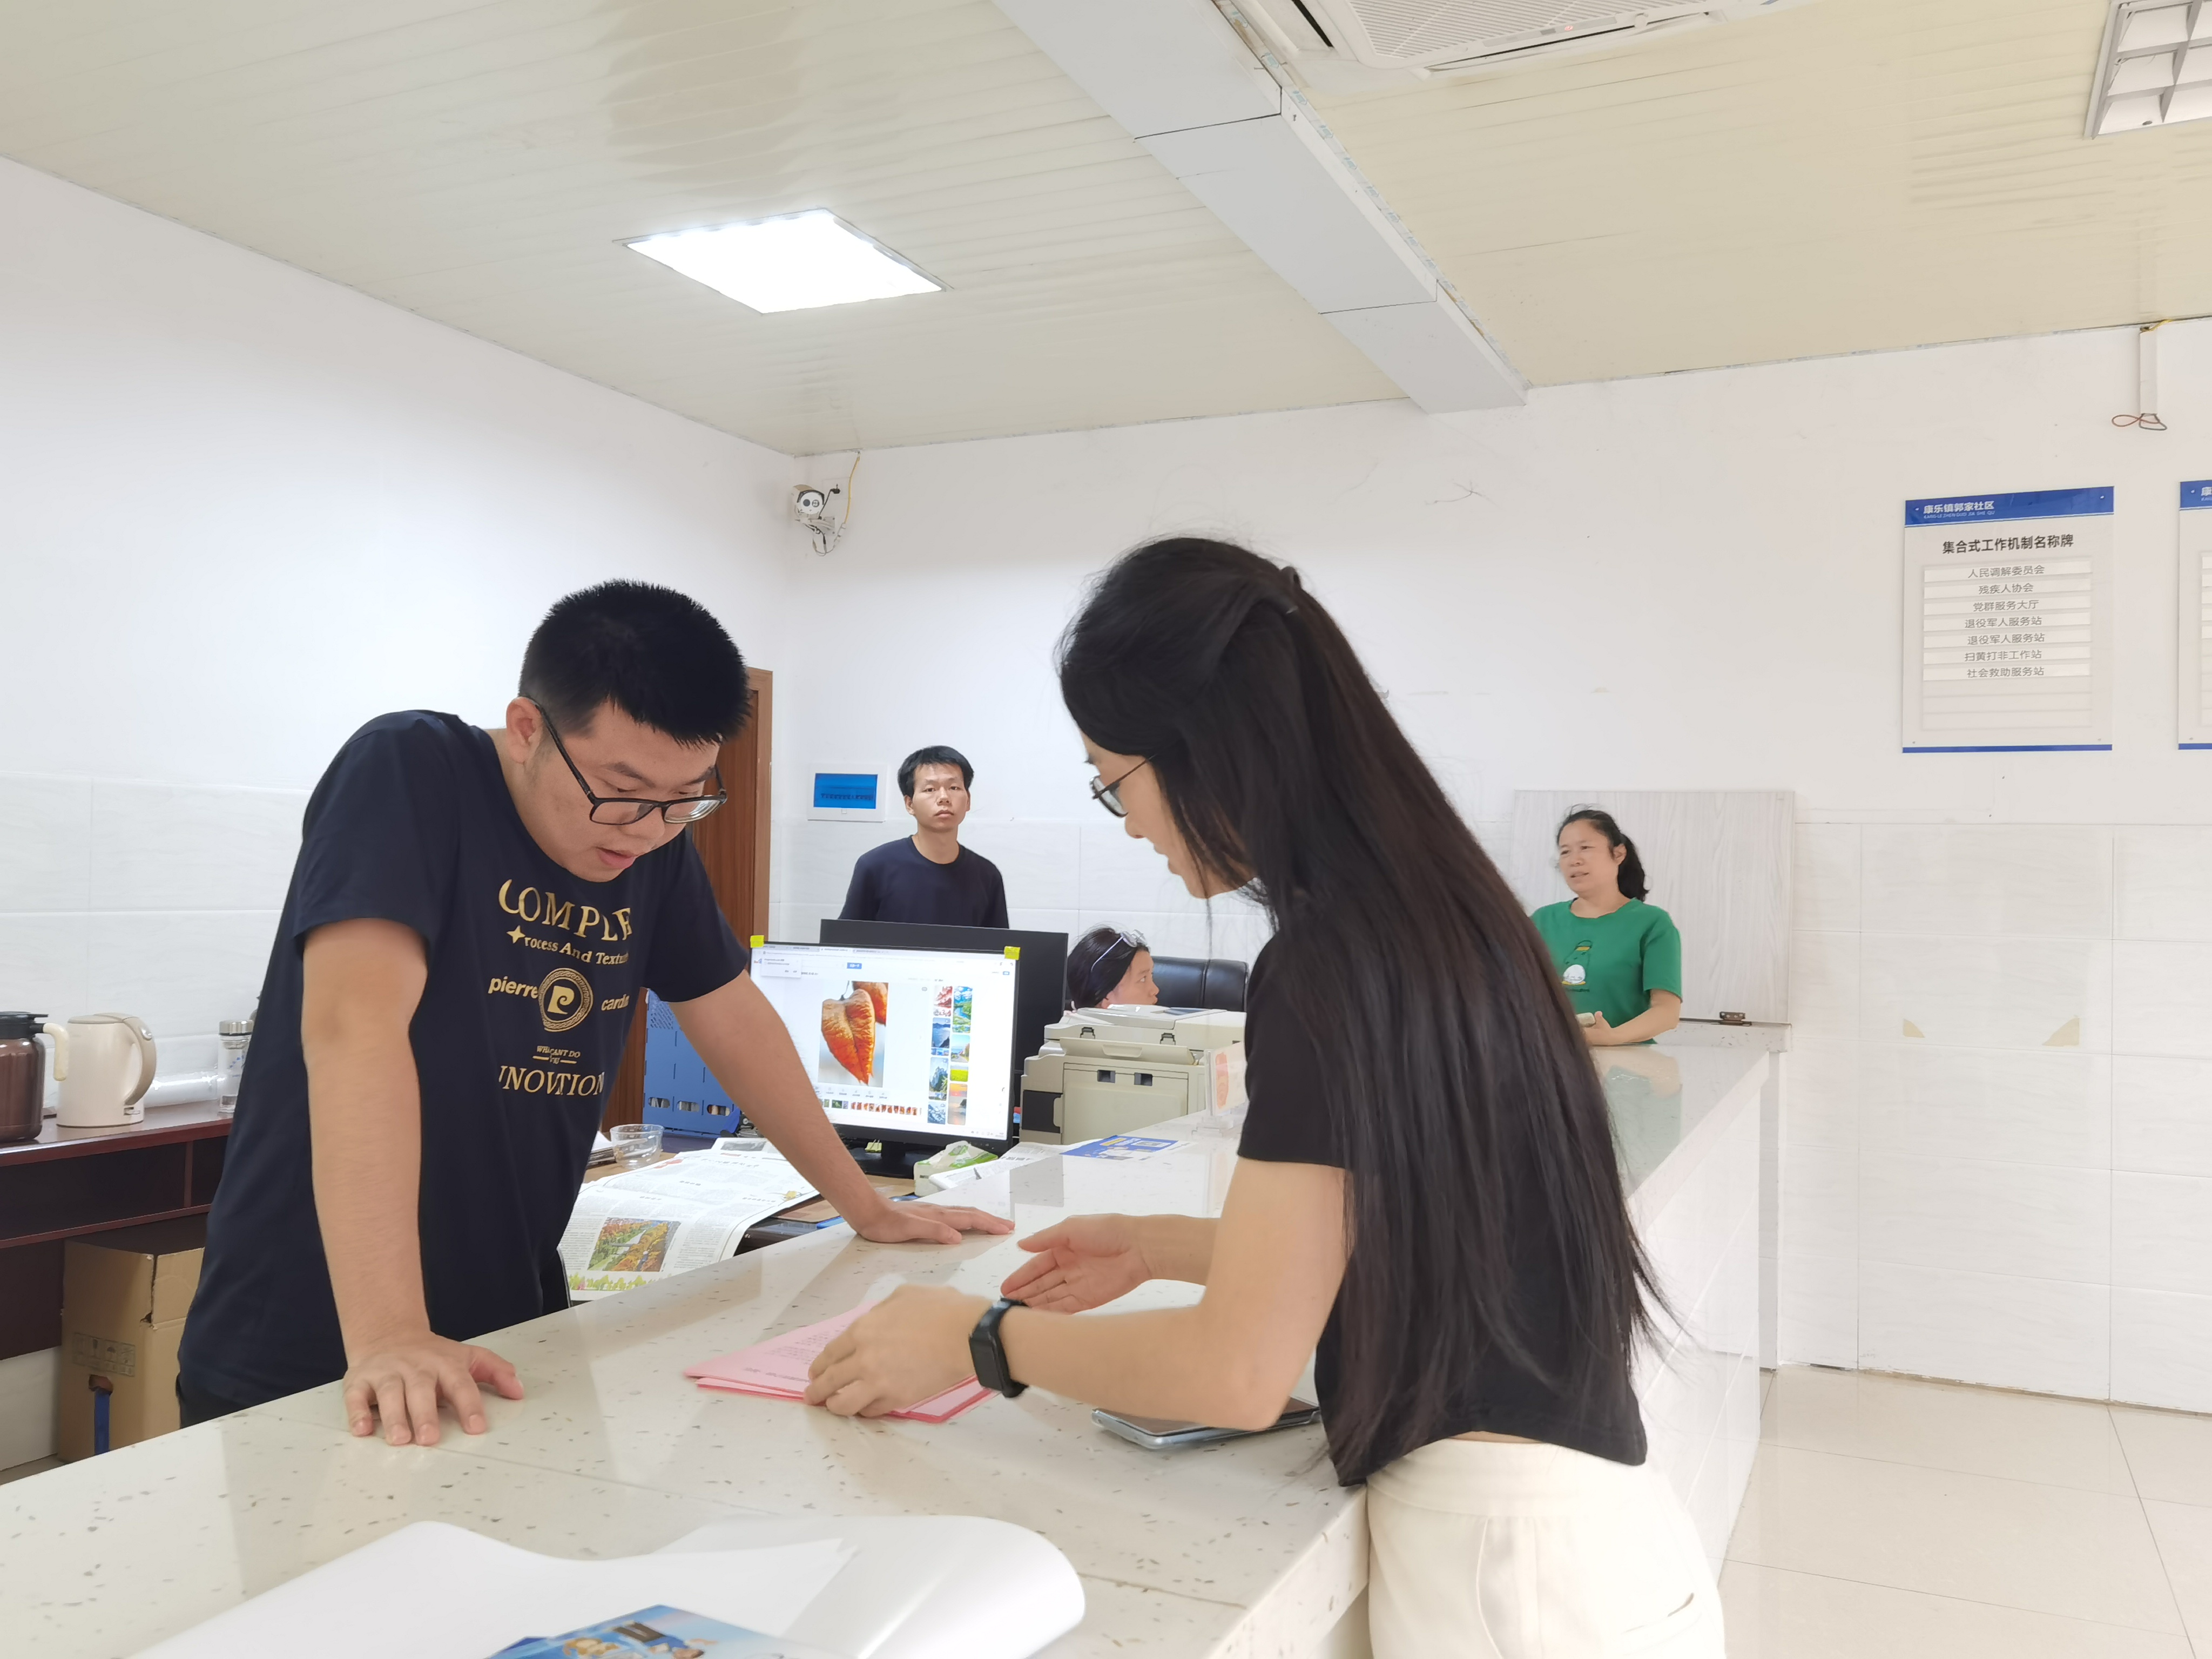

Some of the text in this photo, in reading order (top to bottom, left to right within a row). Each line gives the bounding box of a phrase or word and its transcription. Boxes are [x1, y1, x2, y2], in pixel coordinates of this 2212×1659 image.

[1943, 534, 2074, 554] 集合式工作机制名称牌
[1967, 565, 2045, 578] 人民调解委员会
[1978, 583, 2034, 595] 残疾人协会
[1973, 600, 2039, 612] 党群服务大厅
[1965, 616, 2042, 628] 退役军人服务站
[1967, 632, 2045, 645] 退役军人服务站
[1964, 650, 2042, 662] 扫黄打非工作站
[1967, 666, 2045, 678] 社会救助服务站
[559, 942, 593, 963] And
[488, 976, 539, 999] pierre
